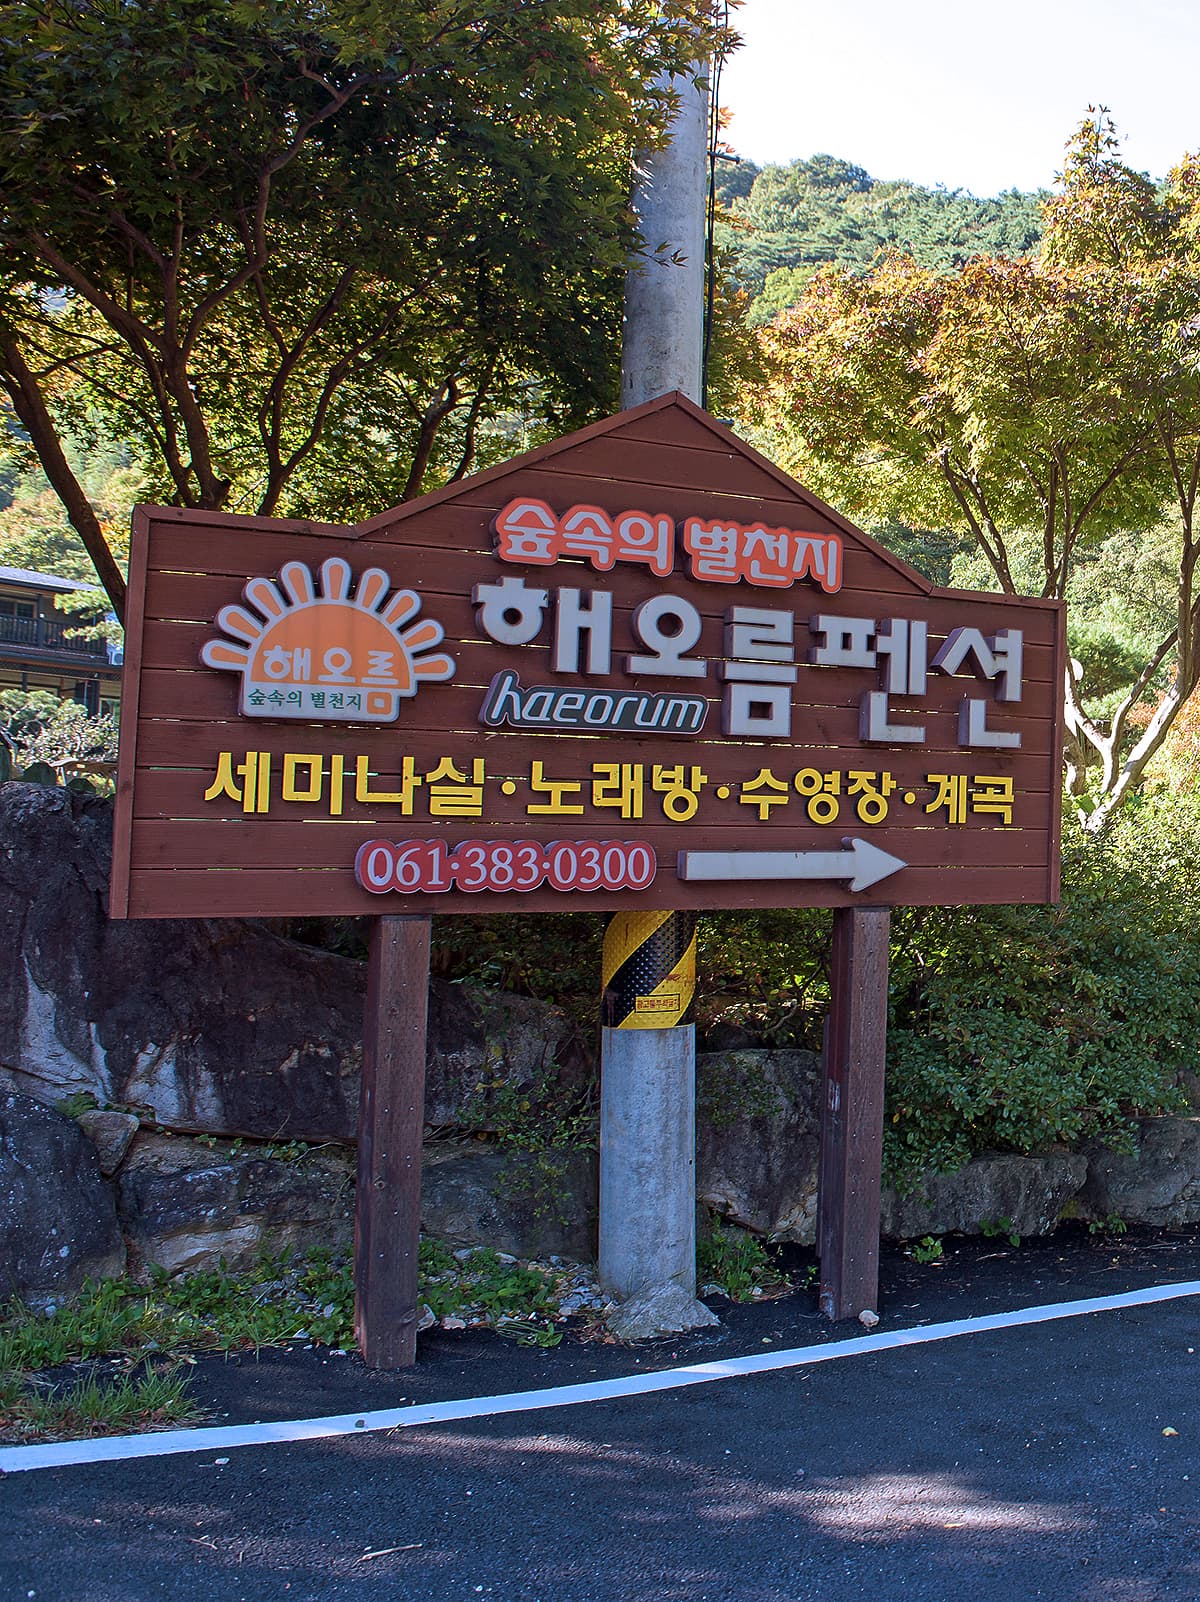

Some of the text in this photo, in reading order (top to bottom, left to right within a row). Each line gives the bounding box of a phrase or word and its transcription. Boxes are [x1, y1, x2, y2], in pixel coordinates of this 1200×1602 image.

[503, 504, 838, 588] 숲속의 별천지
[263, 645, 399, 715] 해오름
[472, 576, 1024, 749] 해오름펜션
[248, 688, 362, 711] 숲속의 별천지
[491, 675, 705, 729] haeorum
